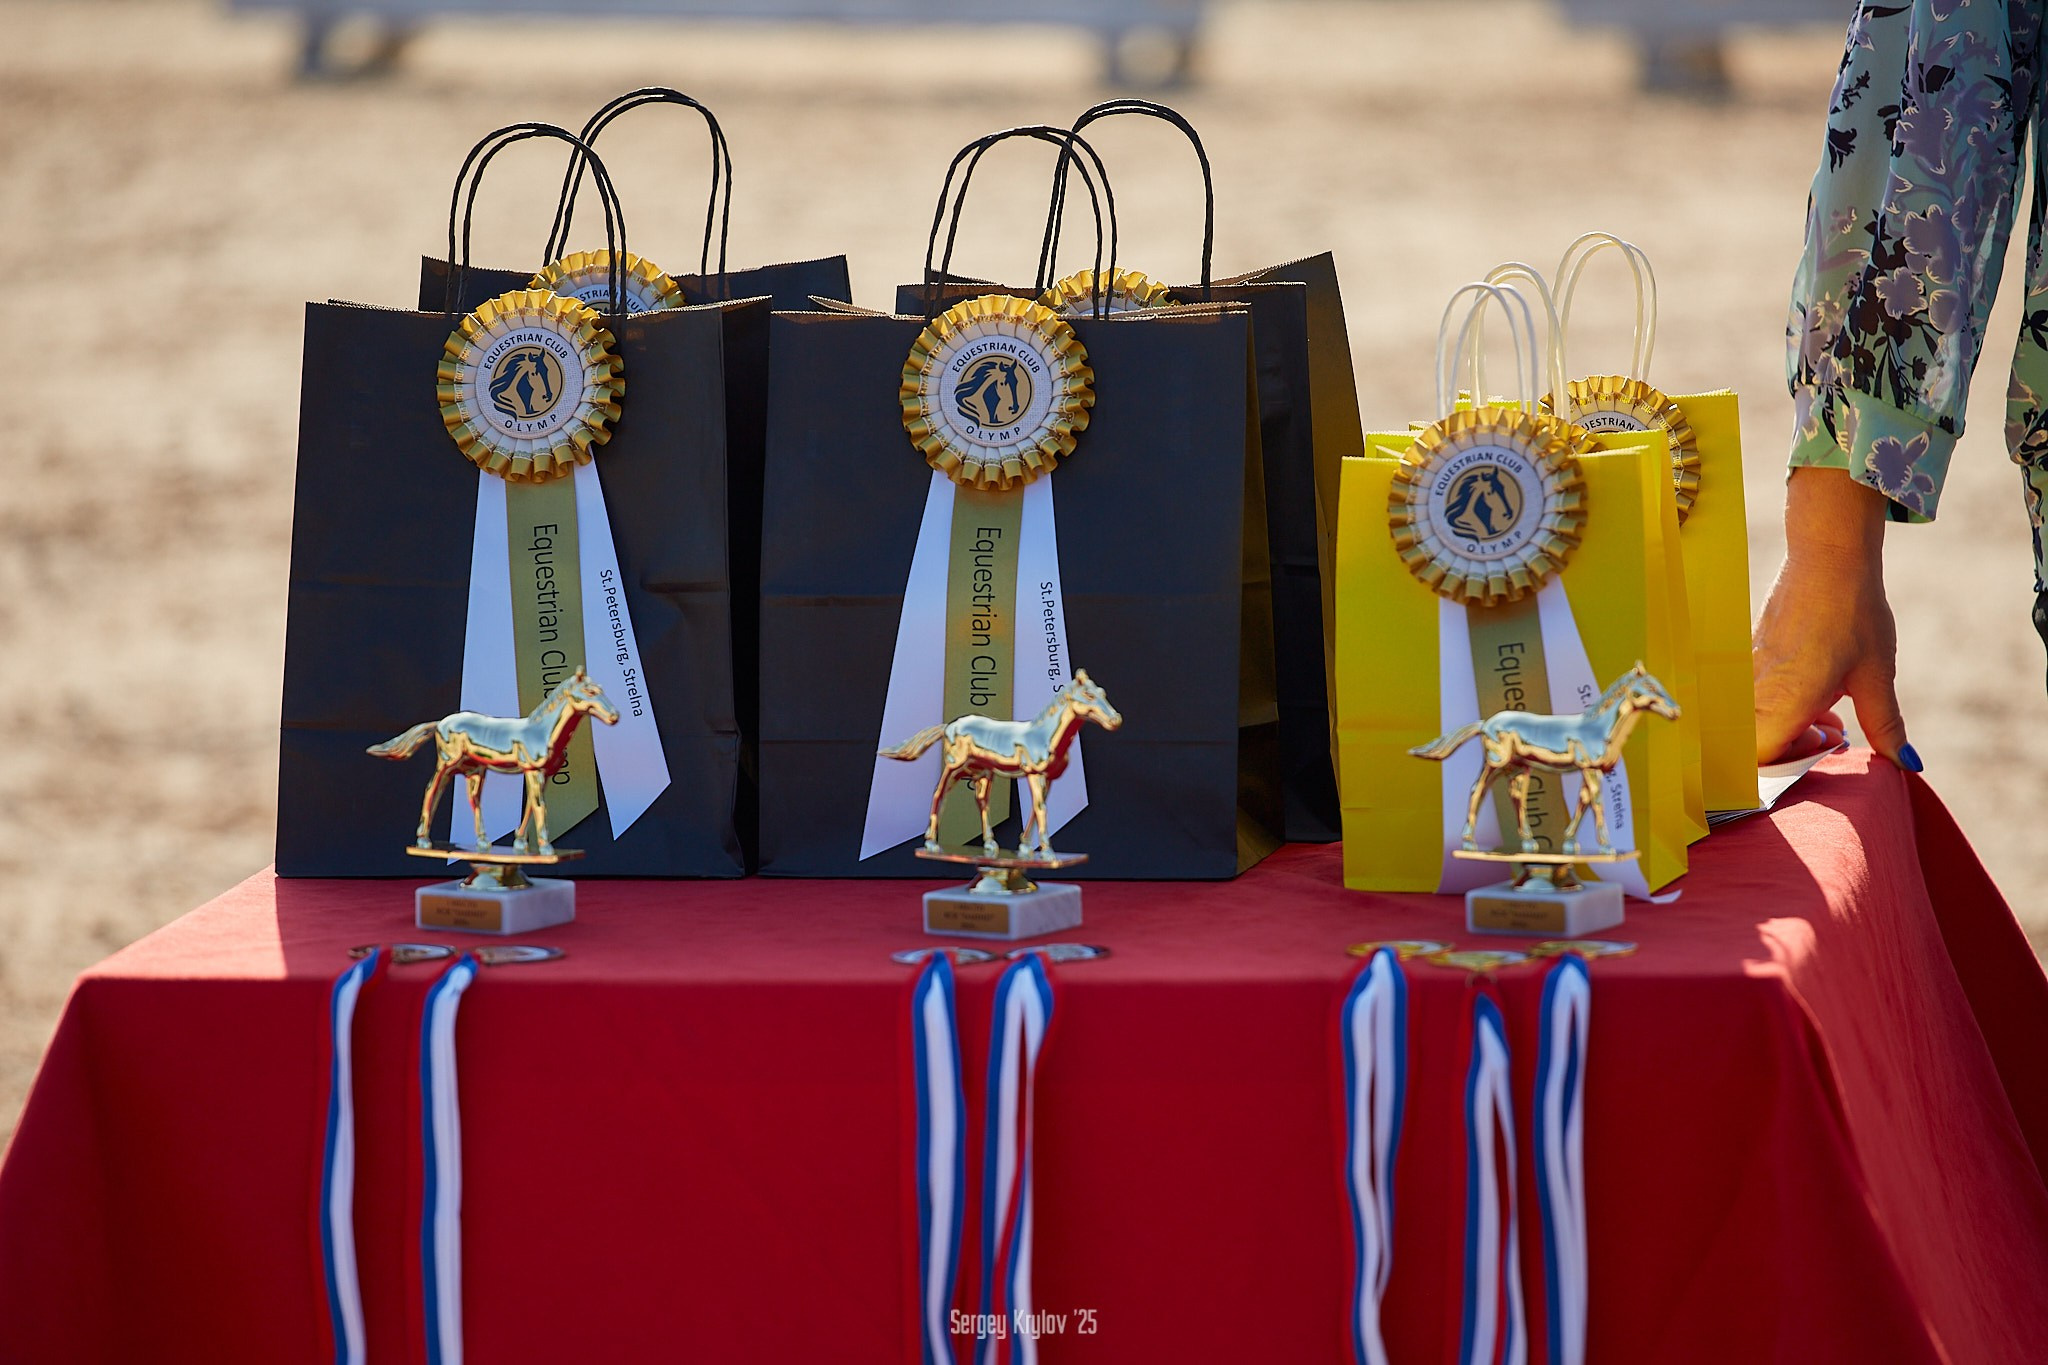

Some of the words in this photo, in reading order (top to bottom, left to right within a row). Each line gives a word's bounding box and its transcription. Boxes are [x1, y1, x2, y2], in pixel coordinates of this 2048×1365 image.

[483, 333, 543, 370] EQUESTRIAN
[544, 337, 569, 360] CLUB
[951, 341, 1016, 374] EQUESTRIAN
[1017, 349, 1041, 374] CLUB
[504, 412, 558, 433] OLYMP
[965, 425, 1021, 441] OLYMP
[1581, 417, 1635, 431] UESTRIAN
[1434, 451, 1493, 497] EQUESTRIAN
[1495, 453, 1524, 475] CLUB
[1466, 530, 1523, 554] OLYMP
[527, 523, 564, 643] Equestrian
[968, 527, 1002, 647] Equestrian
[623, 667, 643, 717] Strelna
[969, 655, 998, 707] Club
[1494, 642, 1526, 711] Eques
[1609, 783, 1627, 830] Strelna
